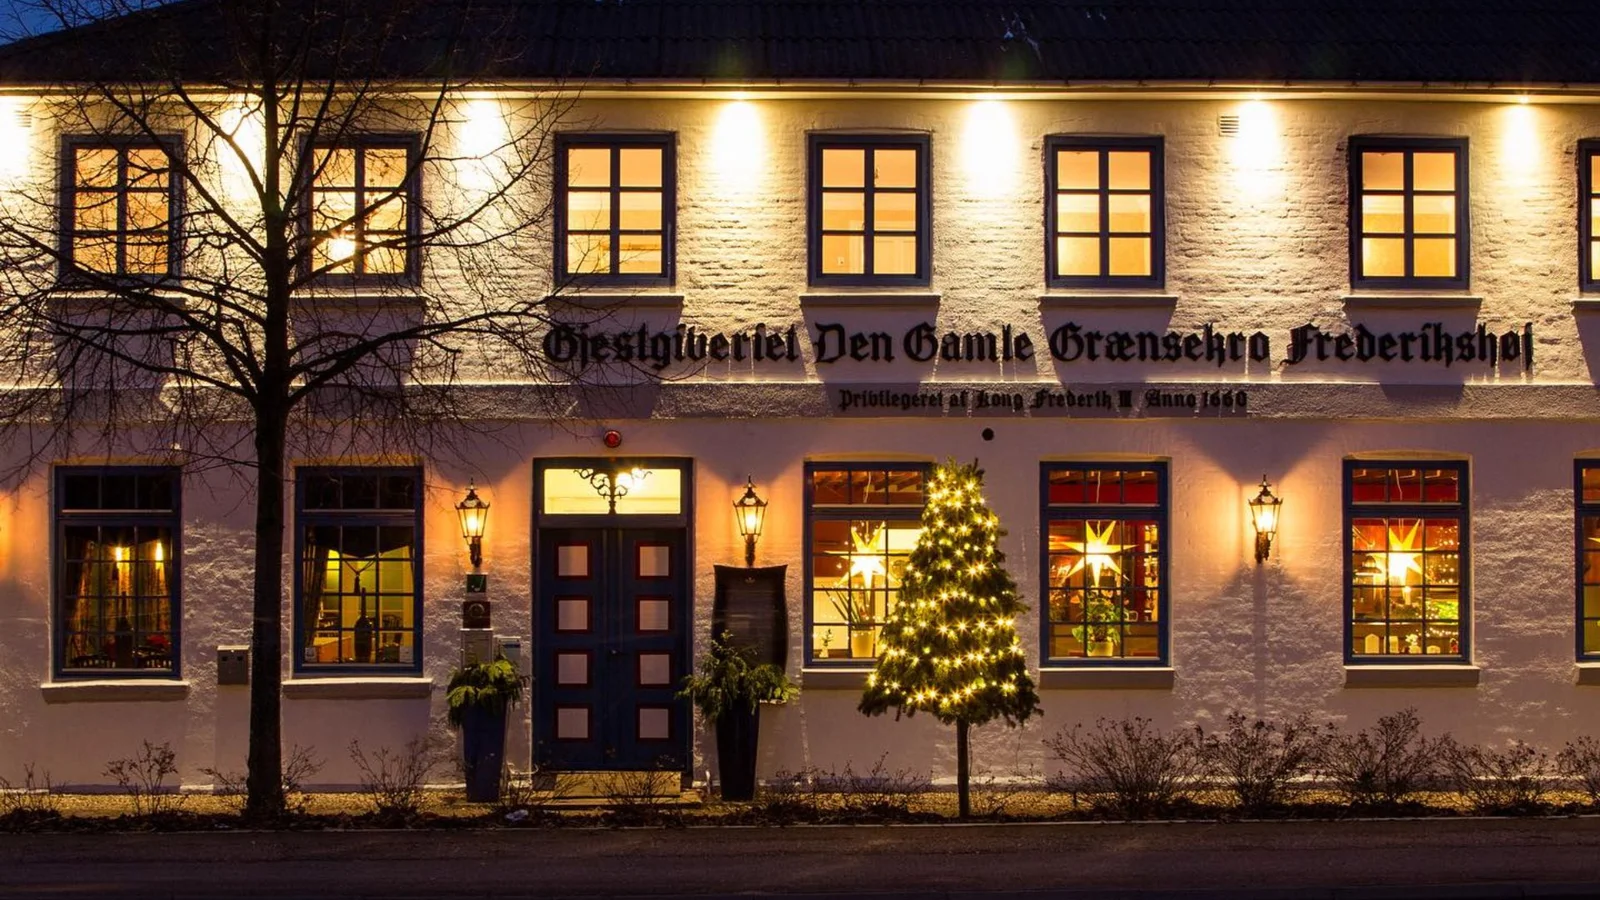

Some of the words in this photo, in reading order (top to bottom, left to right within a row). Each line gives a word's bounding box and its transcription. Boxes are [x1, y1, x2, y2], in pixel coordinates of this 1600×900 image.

[814, 322, 895, 363] Den
[903, 322, 1034, 362] Gamle
[1049, 321, 1270, 367] Grænsekro
[1280, 321, 1533, 370] Frederikshøj
[838, 389, 943, 410] Privilegeret
[949, 389, 969, 408] af
[975, 390, 1024, 409] Kong
[1030, 387, 1112, 408] Frederik
[1145, 388, 1197, 408] Anno
[1202, 390, 1248, 408] 1660
